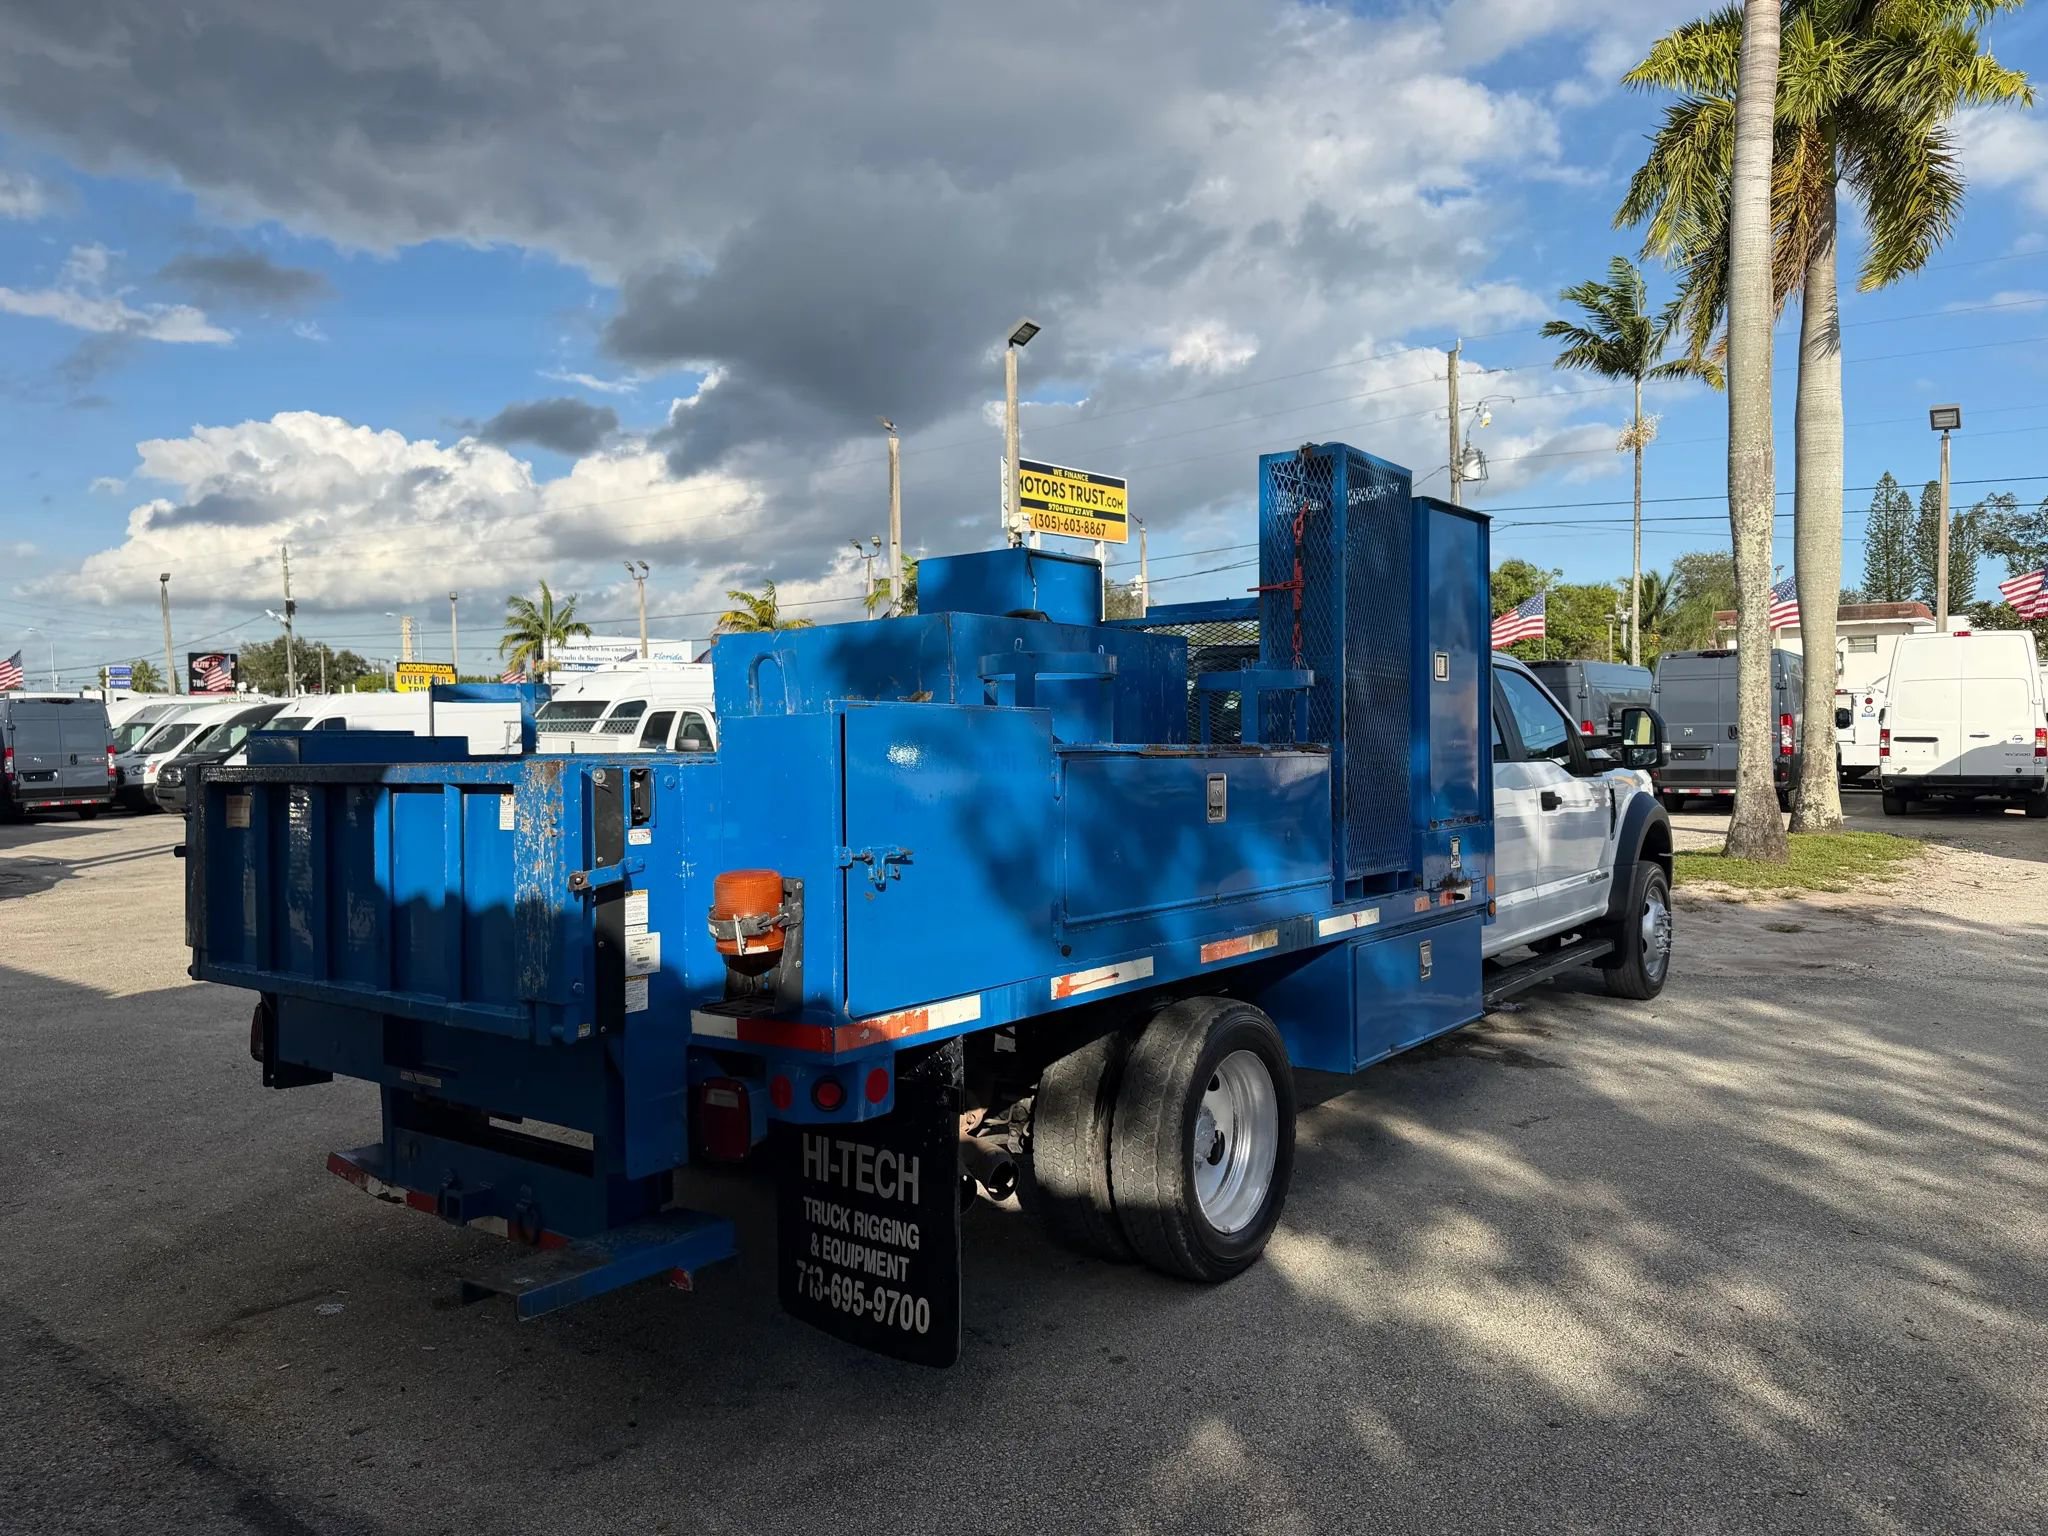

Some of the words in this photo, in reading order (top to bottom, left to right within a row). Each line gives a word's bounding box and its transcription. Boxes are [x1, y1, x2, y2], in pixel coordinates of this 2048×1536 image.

[1053, 468, 1063, 477] WE
[1064, 470, 1089, 482] FINANCE
[1063, 505, 1074, 514] NW
[1074, 507, 1081, 515] 27
[1081, 508, 1094, 517] AVE
[401, 675, 425, 685] OVER
[802, 1132, 920, 1205] HI-TECH
[803, 1196, 851, 1233] TRUCK
[854, 1210, 920, 1251] RIGGING
[810, 1232, 820, 1257] &
[822, 1235, 910, 1283] EQUIPMENT
[796, 1259, 931, 1335] 713-695-9700
